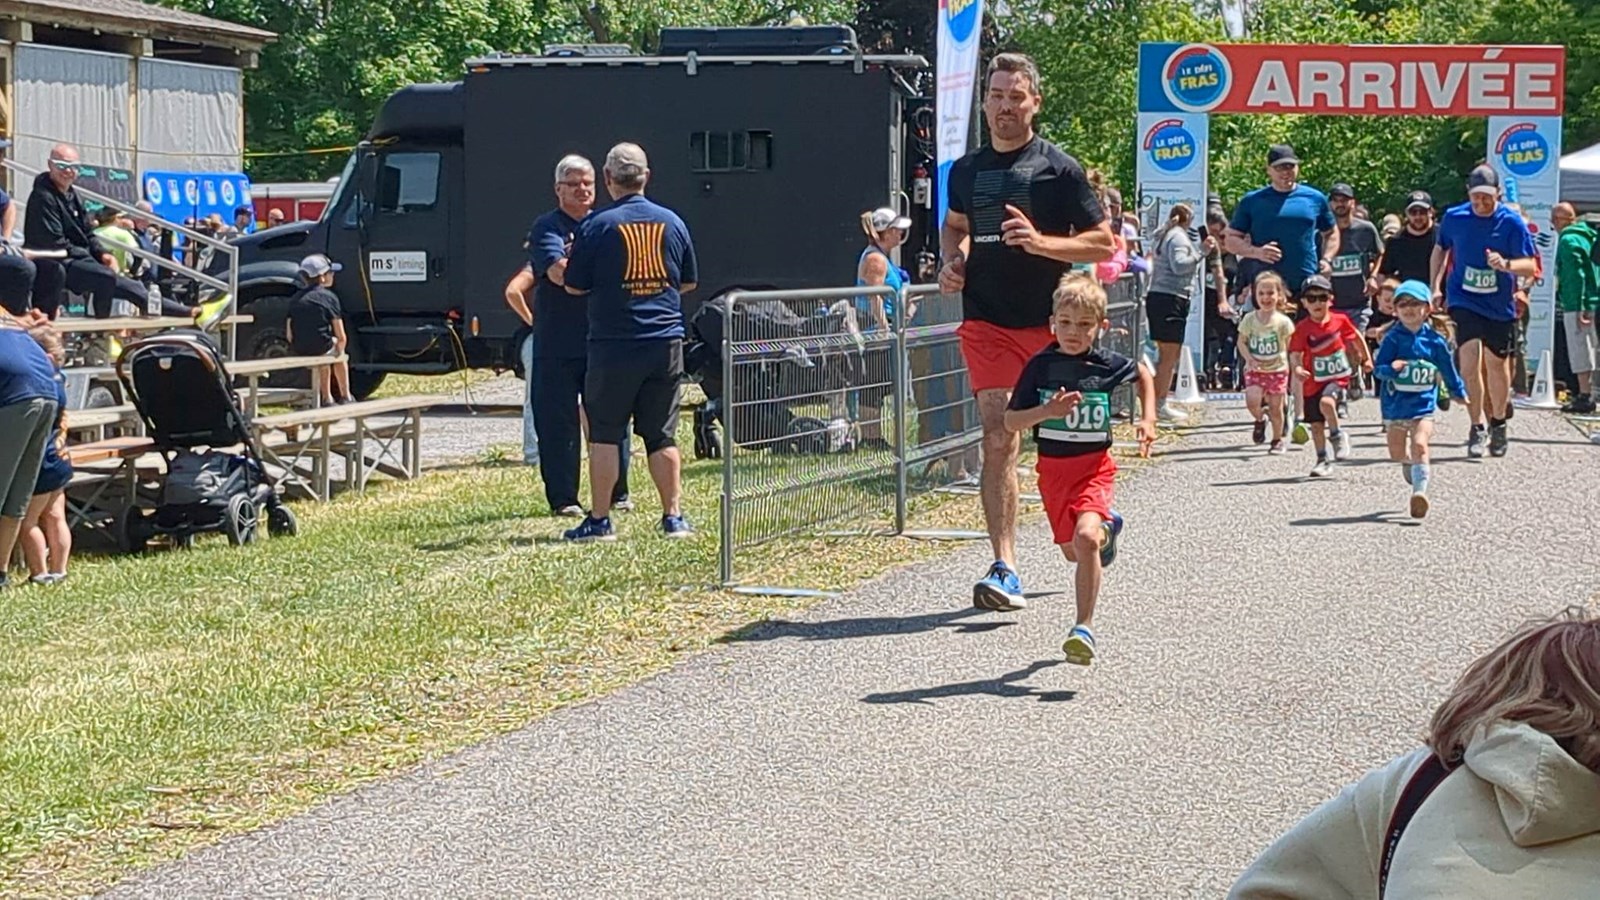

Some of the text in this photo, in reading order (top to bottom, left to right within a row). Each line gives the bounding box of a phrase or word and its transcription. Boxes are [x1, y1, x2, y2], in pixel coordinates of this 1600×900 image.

[1182, 67, 1192, 75] LE
[1247, 48, 1557, 110] ARRIVÉE
[1180, 73, 1219, 91] FRAS
[1155, 138, 1165, 148] LE
[1508, 143, 1518, 151] LE
[1153, 144, 1192, 161] FRAS
[1506, 149, 1544, 165] FRAS
[1475, 274, 1497, 287] 109
[1065, 405, 1105, 429] 019
